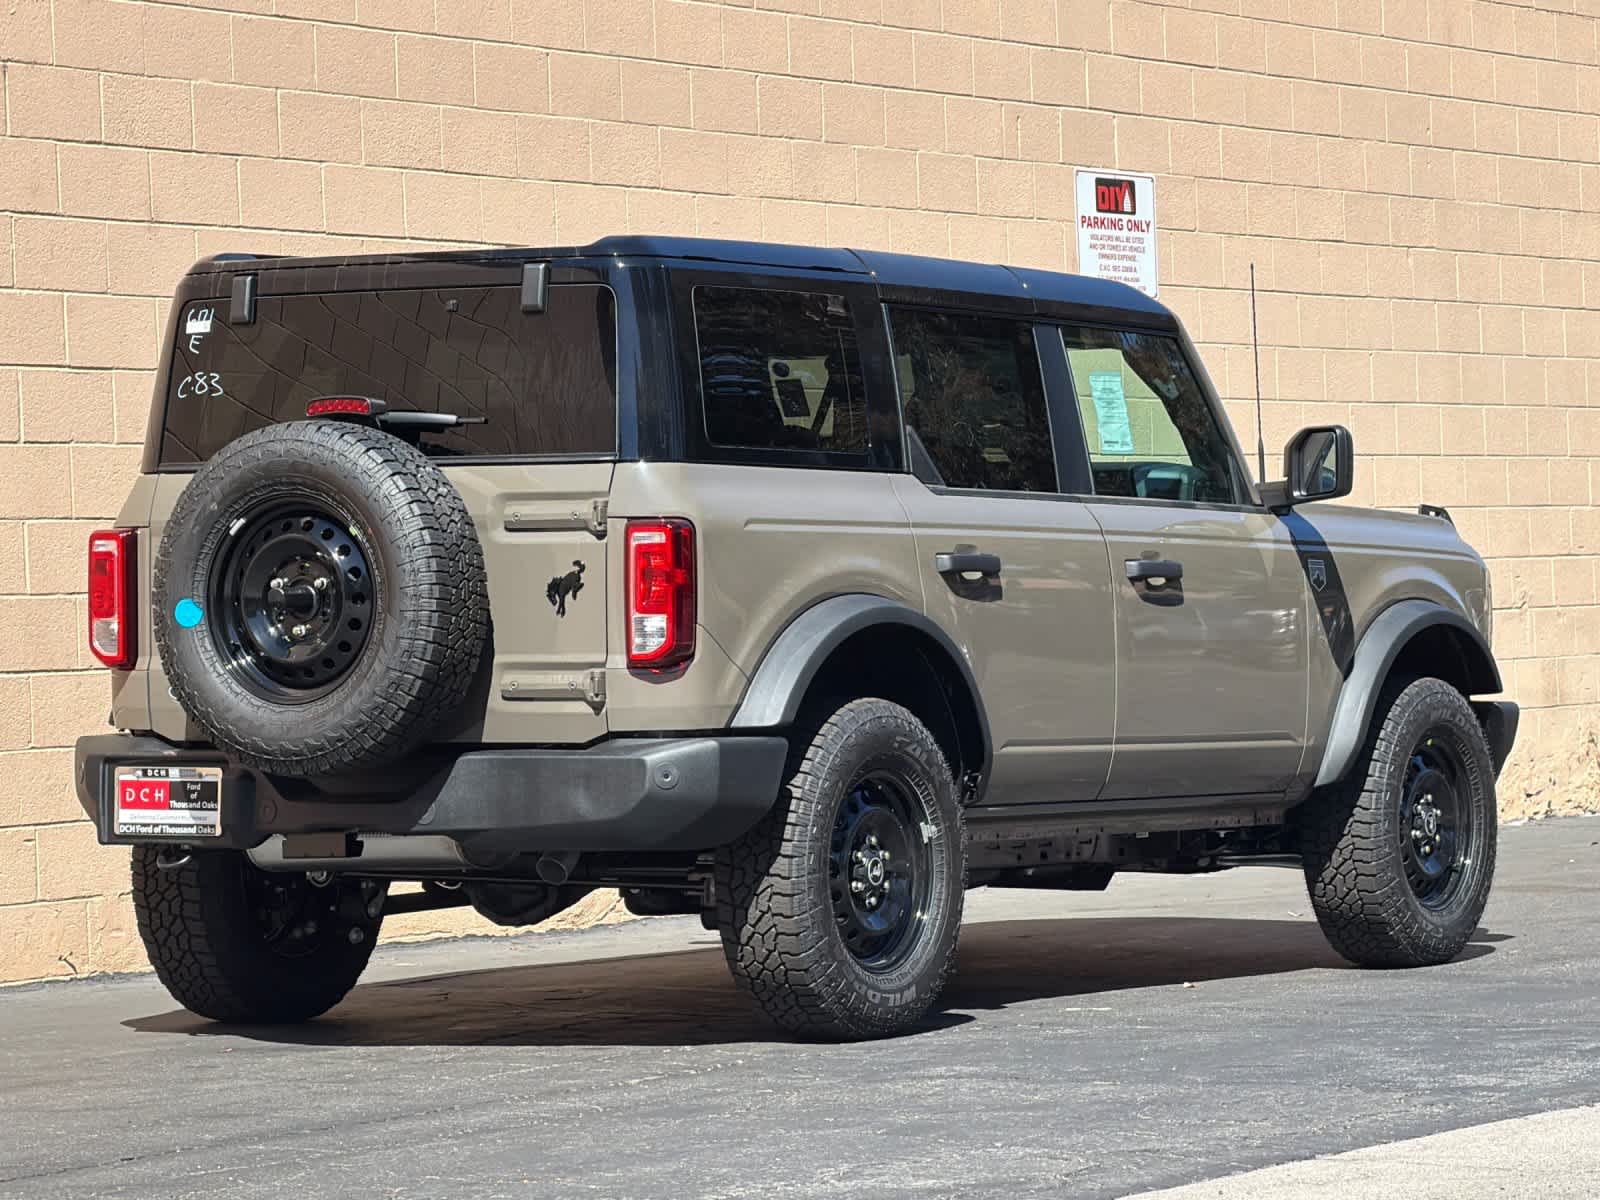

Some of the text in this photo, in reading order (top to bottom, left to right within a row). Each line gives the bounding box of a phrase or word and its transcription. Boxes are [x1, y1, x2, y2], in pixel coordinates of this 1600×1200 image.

[1081, 216, 1151, 233] PARKING ONLY
[187, 783, 201, 791] Ford
[125, 788, 164, 803] DCH
[170, 800, 218, 809] Thousand Oaks
[120, 824, 215, 834] DCH Ford of Thousand Oaks
